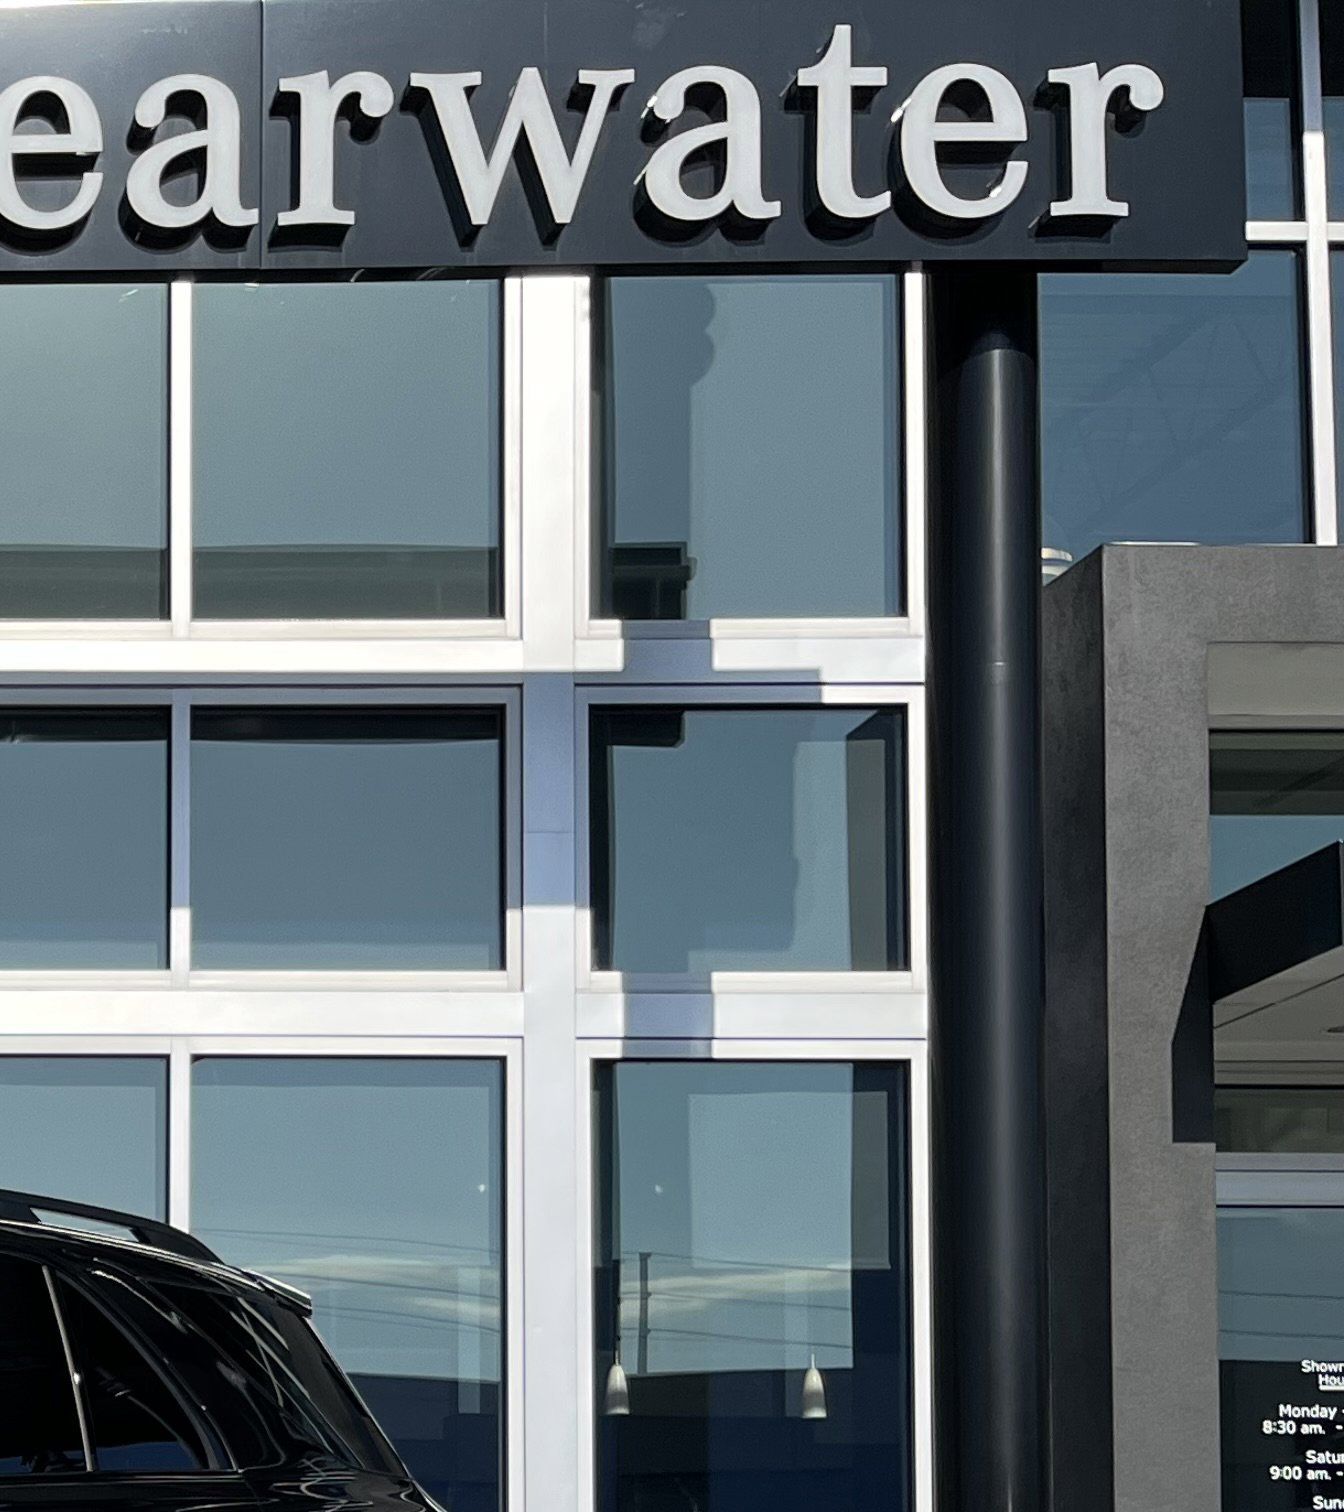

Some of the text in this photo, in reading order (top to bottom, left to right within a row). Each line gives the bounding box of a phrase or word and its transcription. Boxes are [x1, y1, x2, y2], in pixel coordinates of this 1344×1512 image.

[1278, 1403, 1338, 1421] Monday
[1262, 1419, 1297, 1435] 8:30
[1300, 1423, 1326, 1435] am.
[1269, 1465, 1303, 1481] 9:00
[1306, 1469, 1332, 1481] am.
[1312, 1495, 1344, 1510] Sun
